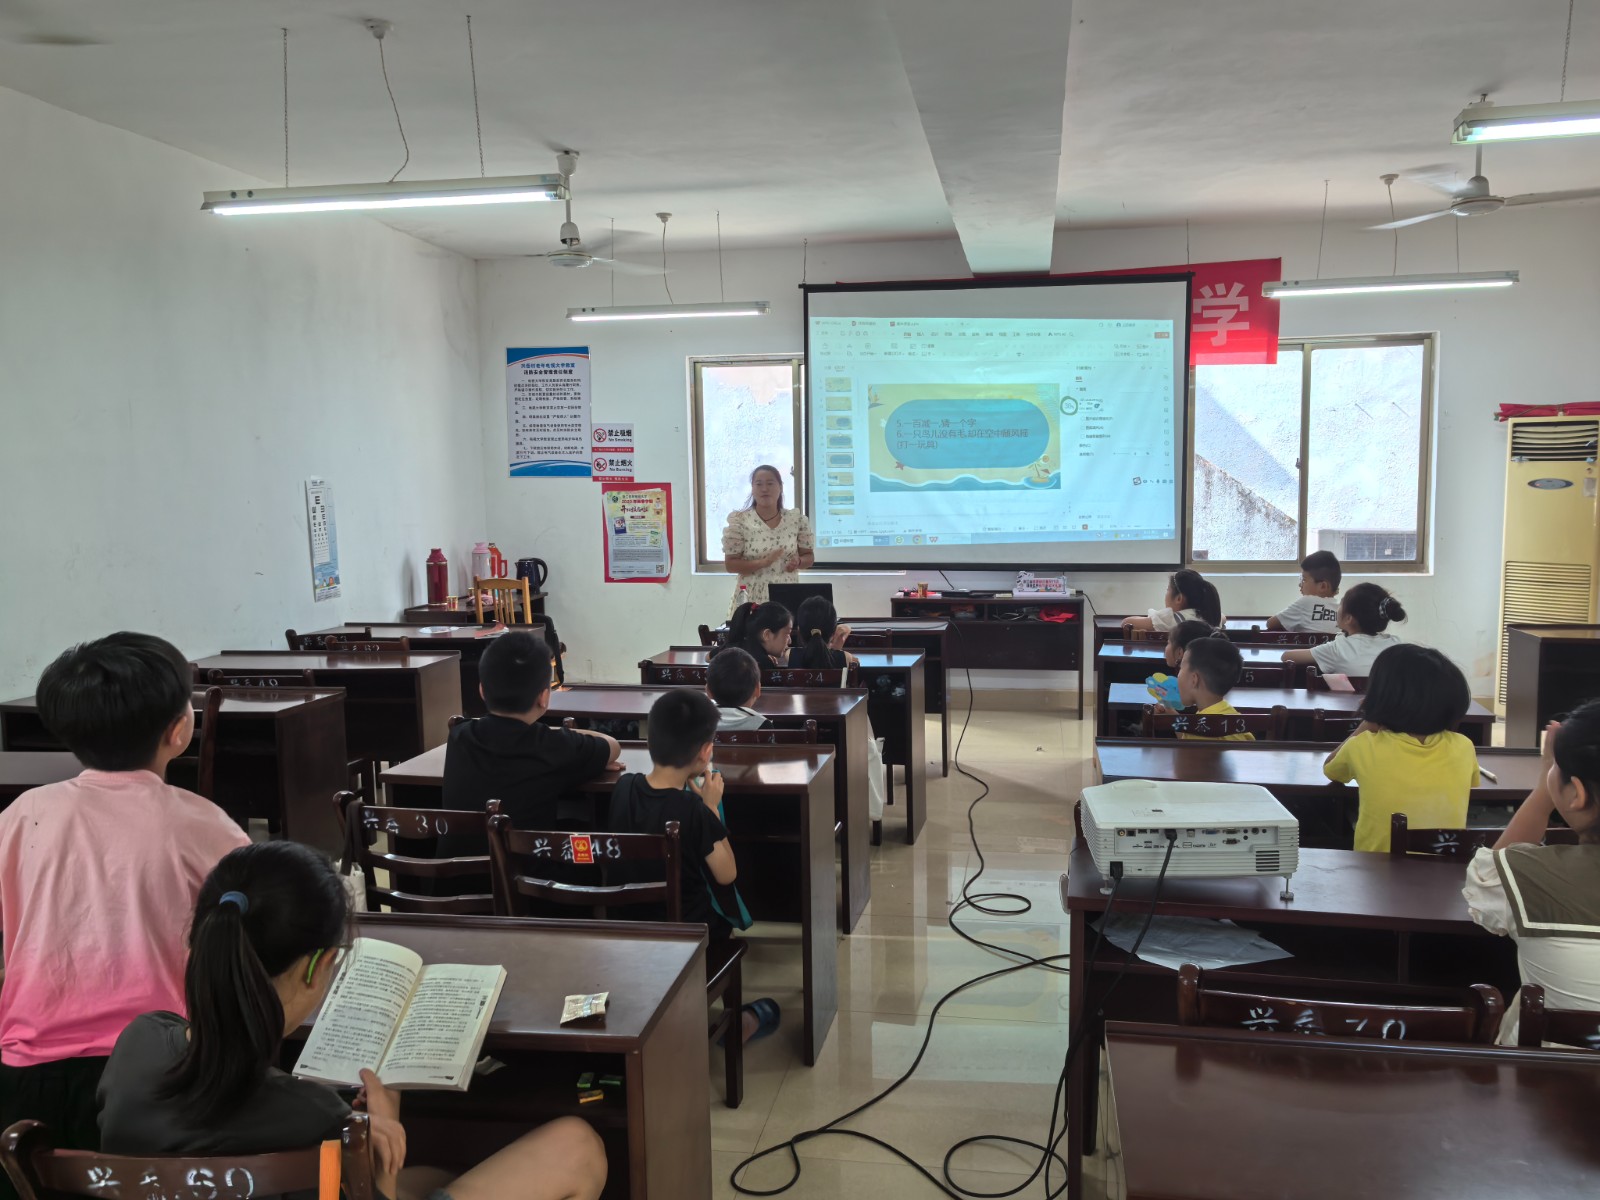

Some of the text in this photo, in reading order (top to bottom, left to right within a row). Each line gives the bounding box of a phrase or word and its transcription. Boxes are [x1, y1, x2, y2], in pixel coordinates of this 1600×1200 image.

[1192, 281, 1249, 347] 学
[608, 429, 632, 437] 禁止吸烟
[608, 459, 633, 467] 禁止烟火
[1220, 718, 1246, 733] 13
[415, 815, 449, 836] 30
[591, 838, 621, 859] 48
